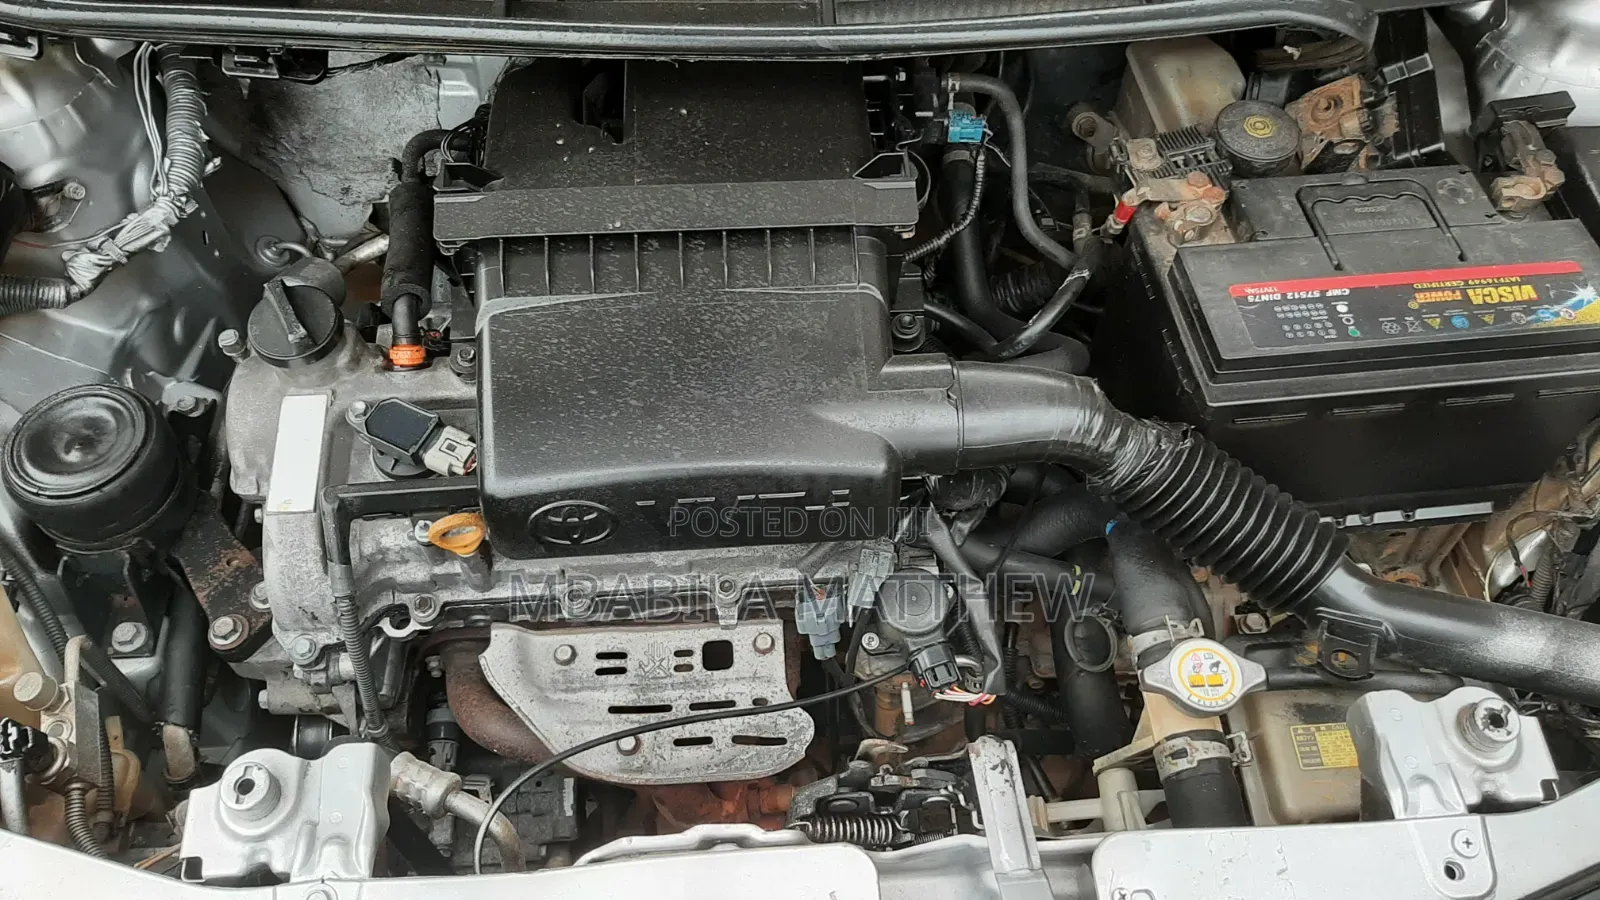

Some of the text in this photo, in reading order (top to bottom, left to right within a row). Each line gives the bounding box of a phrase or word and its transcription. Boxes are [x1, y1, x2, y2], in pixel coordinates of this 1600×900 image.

[1413, 280, 1464, 289] CERTIFIED
[1247, 288, 1350, 303] CMF 57512 DIN75
[1415, 284, 1539, 305] VISCA POWER
